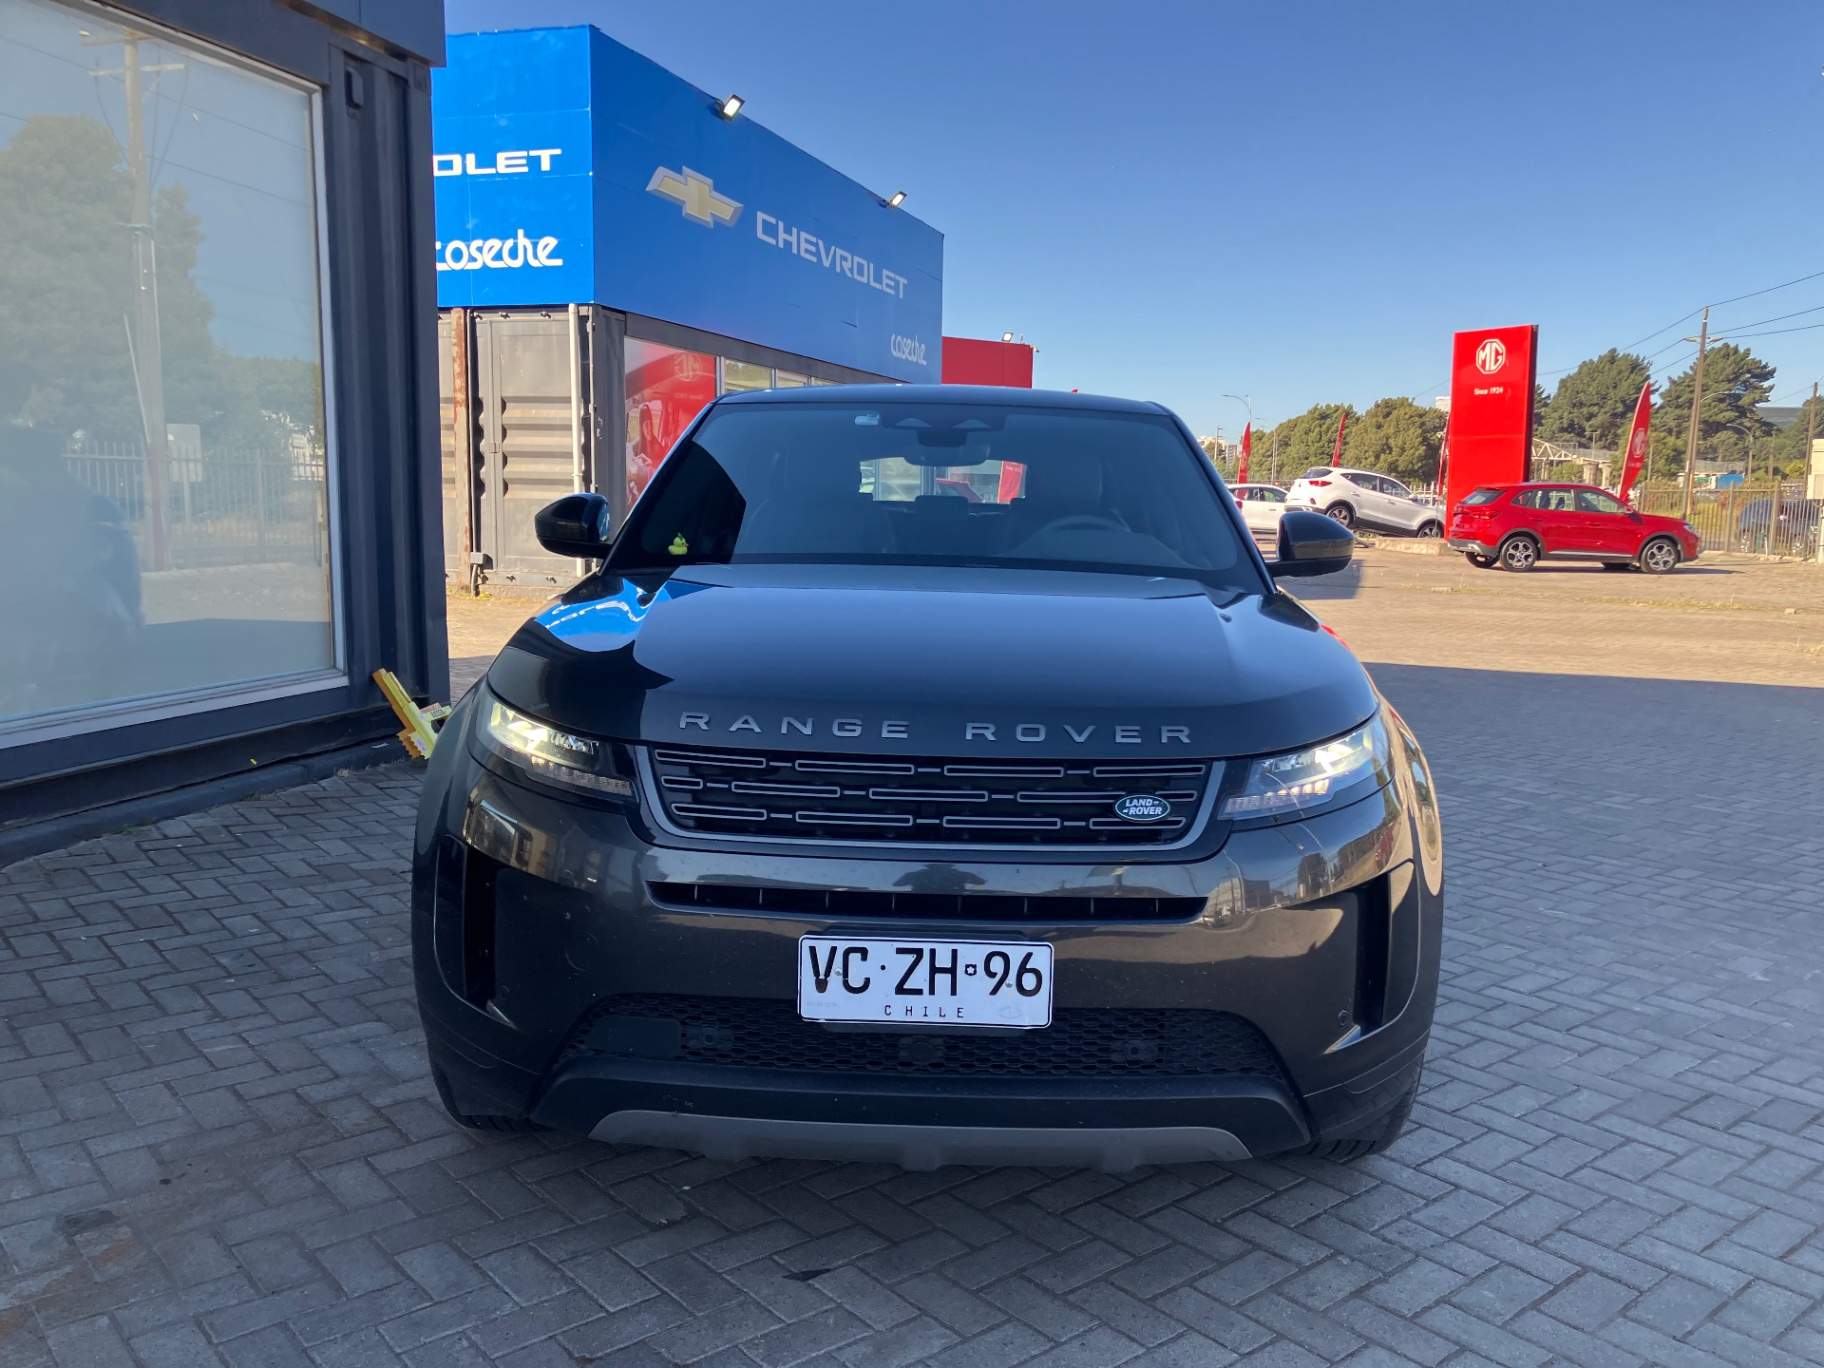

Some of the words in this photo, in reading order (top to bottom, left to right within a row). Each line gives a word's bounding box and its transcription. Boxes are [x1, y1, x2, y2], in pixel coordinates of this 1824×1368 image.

[756, 211, 908, 299] CHEVROLET
[890, 334, 927, 365] coseche
[1479, 342, 1503, 371] MG
[679, 711, 911, 739] RANGE
[965, 723, 1191, 744] ROVER
[884, 1004, 964, 1018] CHILE
